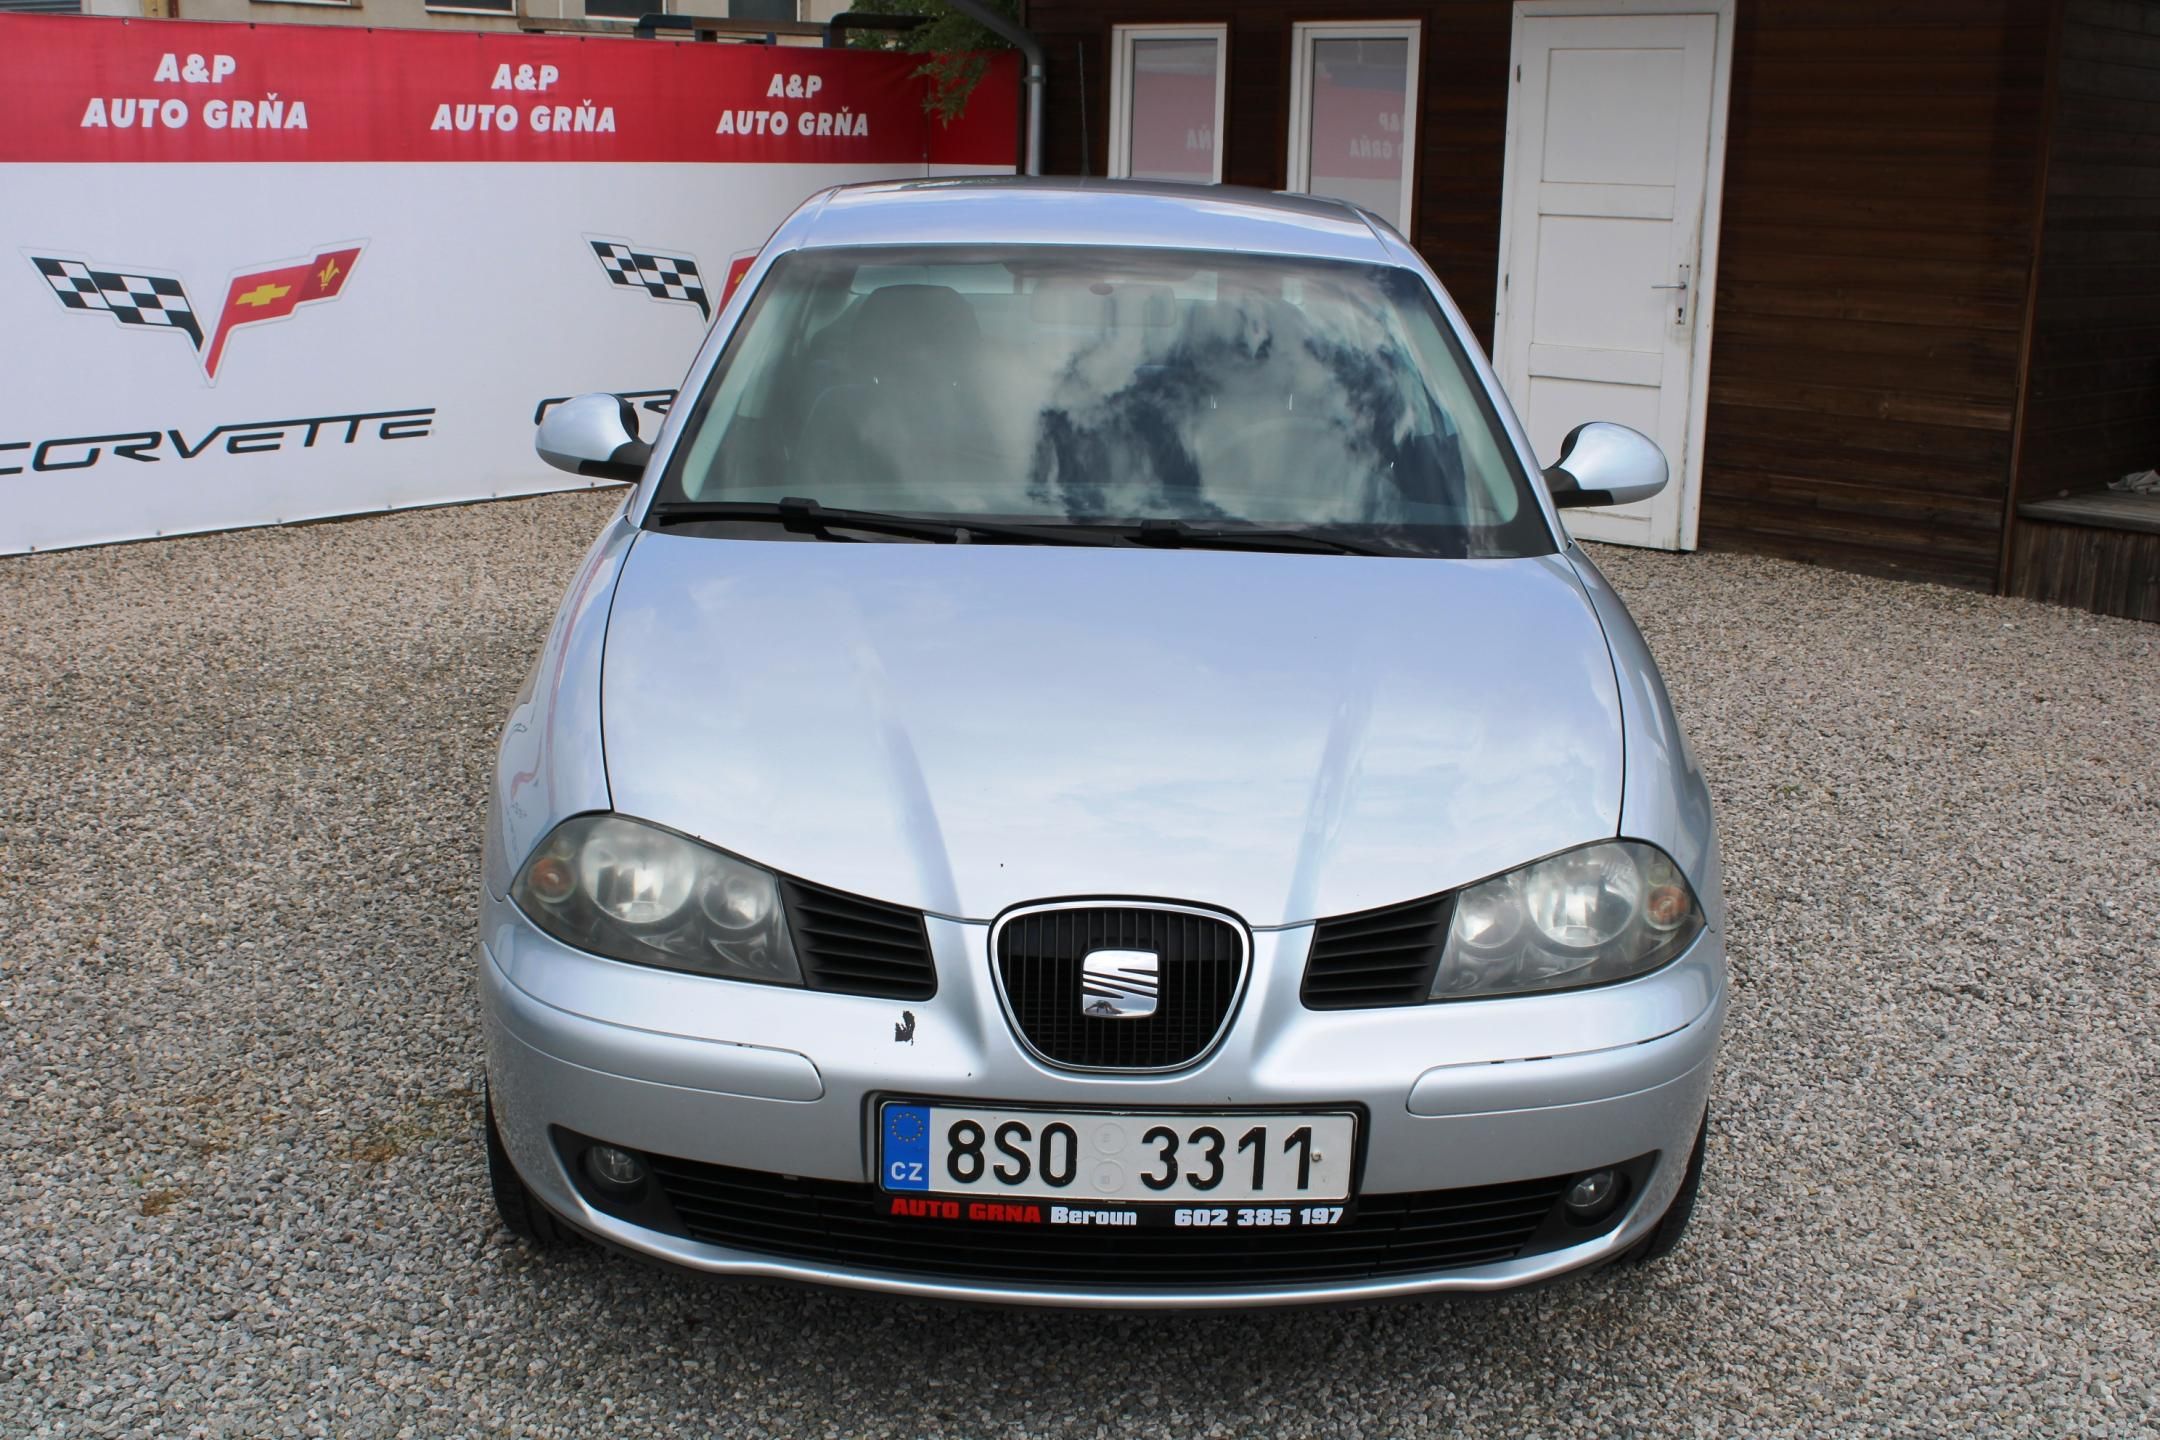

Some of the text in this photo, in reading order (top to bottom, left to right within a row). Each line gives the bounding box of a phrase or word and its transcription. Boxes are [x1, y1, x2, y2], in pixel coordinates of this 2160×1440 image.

[153, 53, 236, 83] A&P
[491, 63, 559, 91] A&P
[766, 73, 823, 99] A&P
[80, 92, 308, 129] AUTO GRŇA
[430, 98, 616, 133] AUTO GRŇA
[716, 106, 869, 137] AUTO GRŇA
[891, 1161, 923, 1182] CZ
[1140, 1125, 1313, 1191] 3311
[890, 1198, 960, 1219] AUTO
[1050, 1206, 1138, 1226] Beroun
[1174, 1208, 1228, 1227] 602
[1237, 1208, 1292, 1226] 385
[1300, 1207, 1344, 1225] 197
